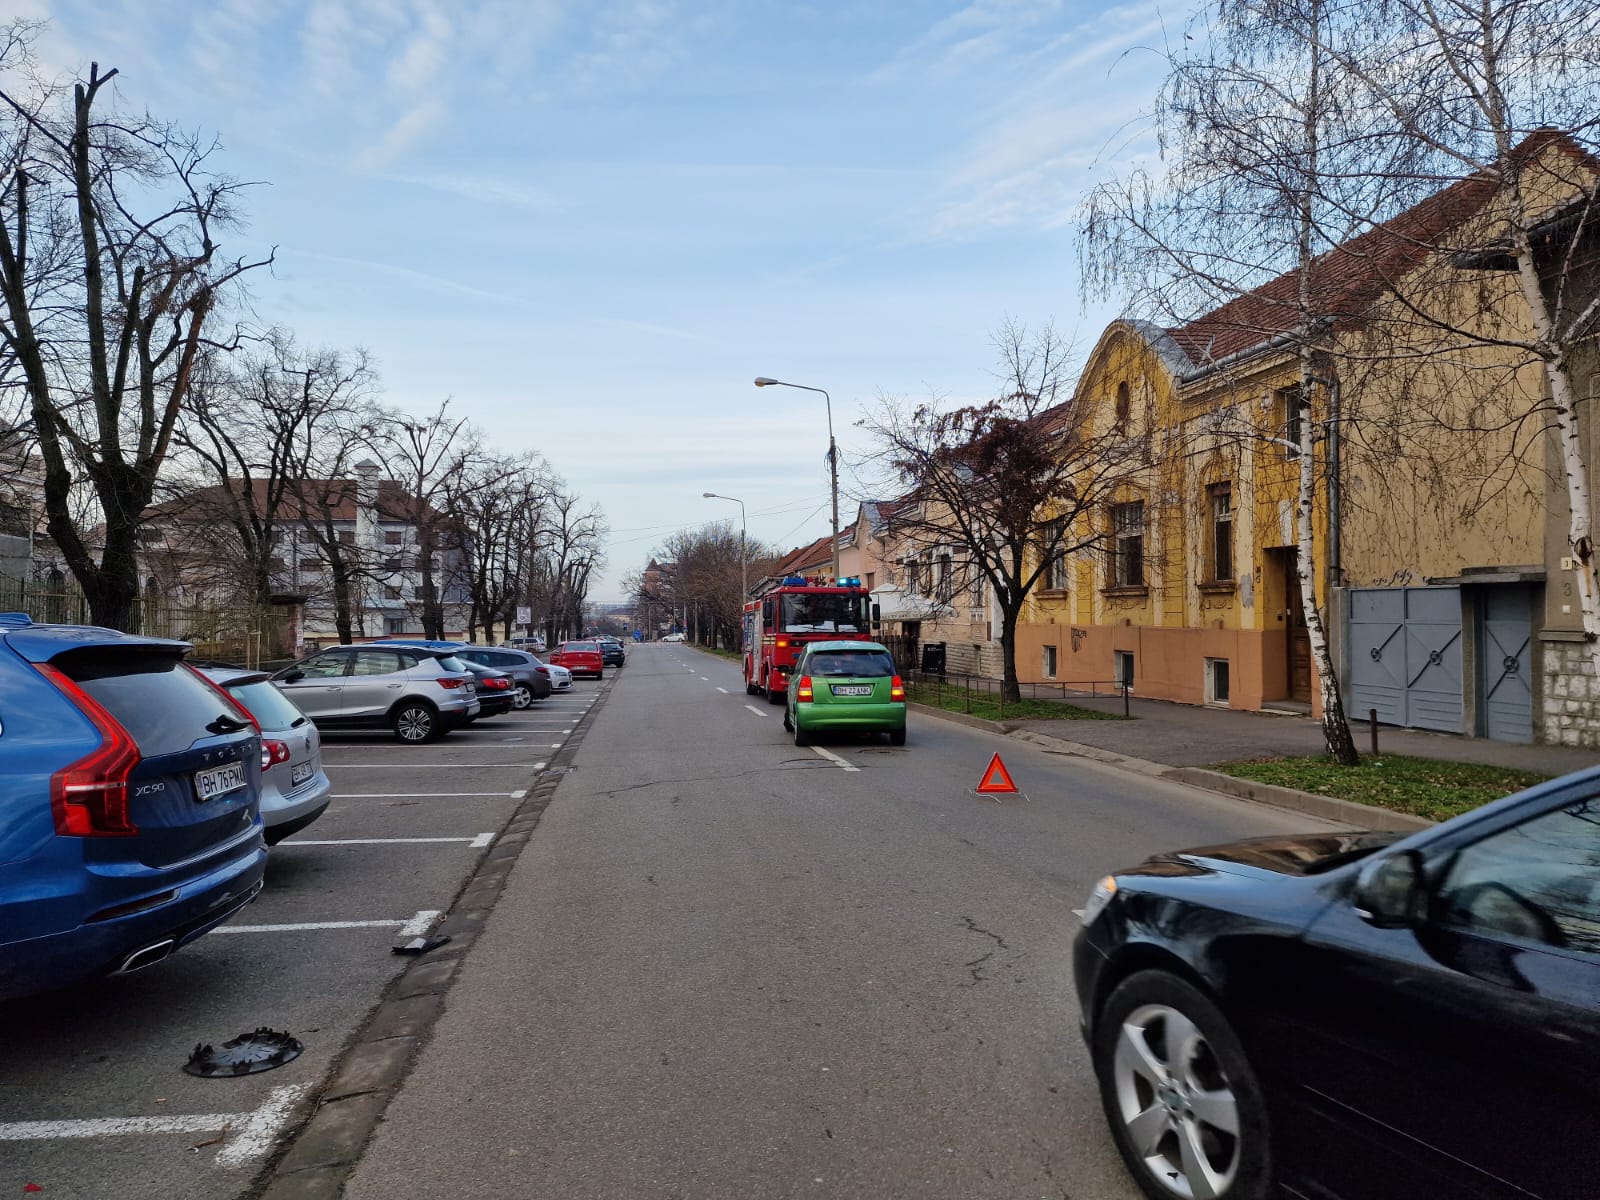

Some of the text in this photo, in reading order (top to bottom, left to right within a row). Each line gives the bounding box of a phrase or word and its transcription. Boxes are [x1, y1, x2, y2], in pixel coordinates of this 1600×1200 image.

[1563, 582, 1572, 597] 3
[136, 783, 165, 797] XC90
[202, 773, 218, 795] BH
[217, 771, 229, 790] 76
